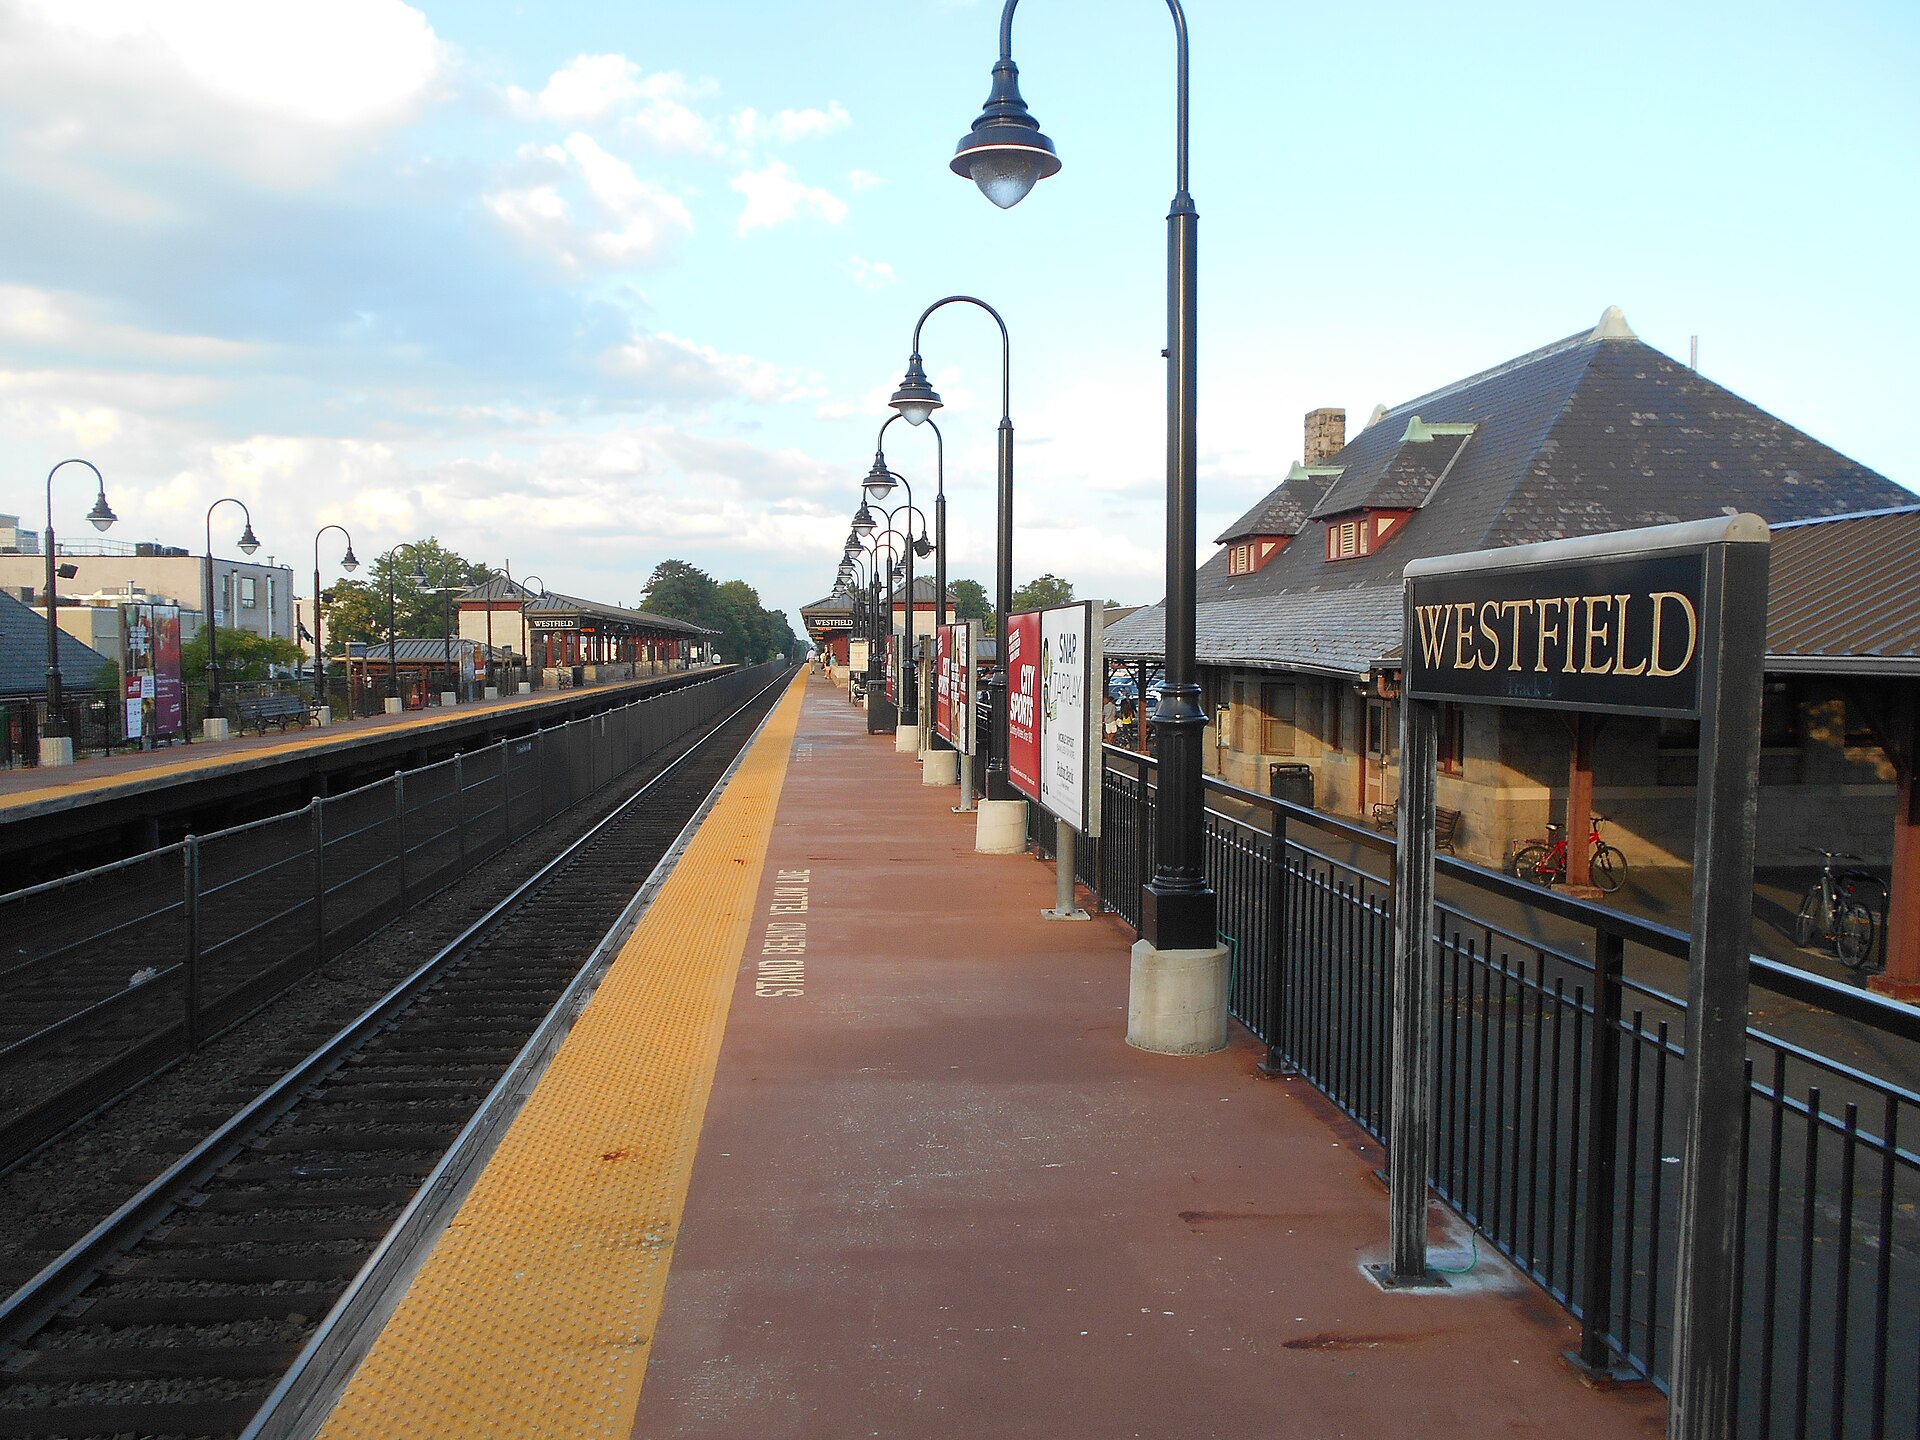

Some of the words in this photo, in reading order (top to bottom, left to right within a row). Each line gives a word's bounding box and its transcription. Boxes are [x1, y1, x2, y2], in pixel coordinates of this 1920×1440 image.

[534, 620, 574, 628] WESTFIELD
[814, 619, 854, 627] WESTFIELD
[1415, 592, 1698, 677] WESTFIELD
[1021, 664, 1035, 696] CITY
[1010, 692, 1033, 729] SPORTS
[776, 869, 810, 883] LINE
[769, 887, 808, 915] YELLOW
[761, 922, 806, 954] BEHIND
[755, 960, 804, 997] STAND
